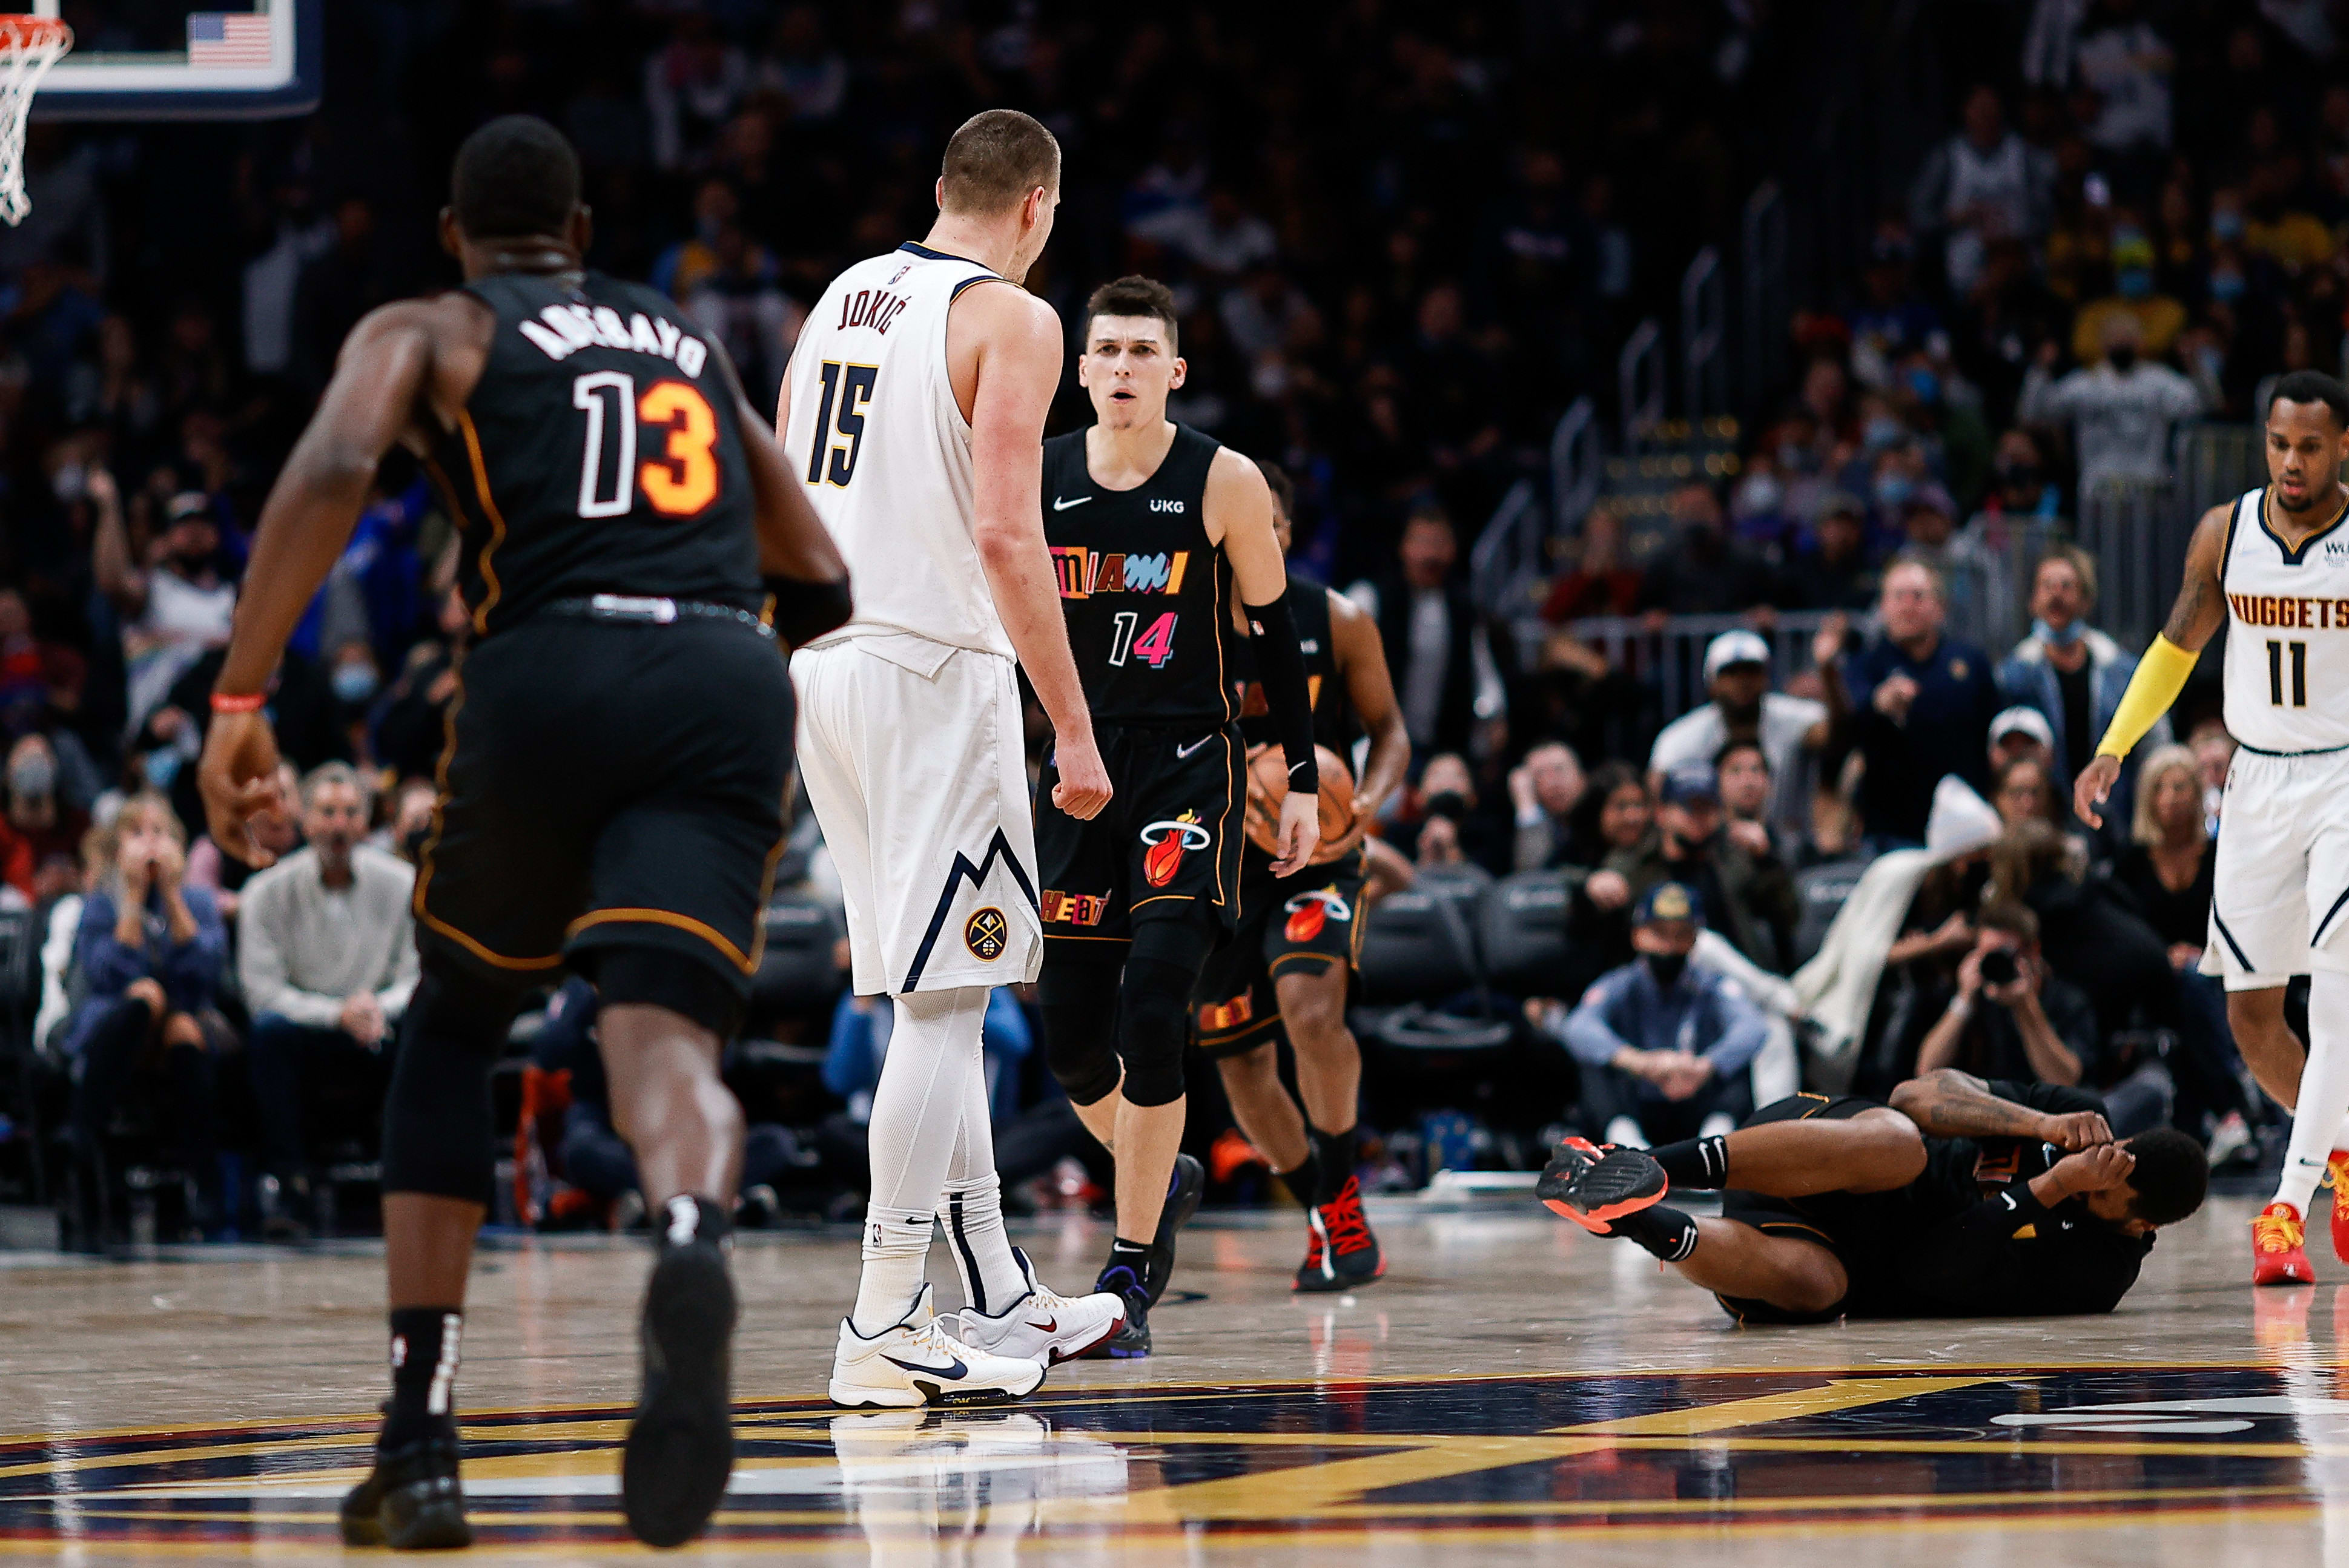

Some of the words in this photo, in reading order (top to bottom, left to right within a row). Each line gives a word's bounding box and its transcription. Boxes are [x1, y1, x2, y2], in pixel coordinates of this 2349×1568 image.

[838, 290, 911, 335] JOKIĆ
[573, 370, 719, 519] 13
[806, 360, 879, 489] 15
[1150, 499, 1184, 513] UKG
[1109, 611, 1178, 668] 14
[2228, 593, 2349, 629] NUGGETS
[2267, 639, 2306, 707] 11
